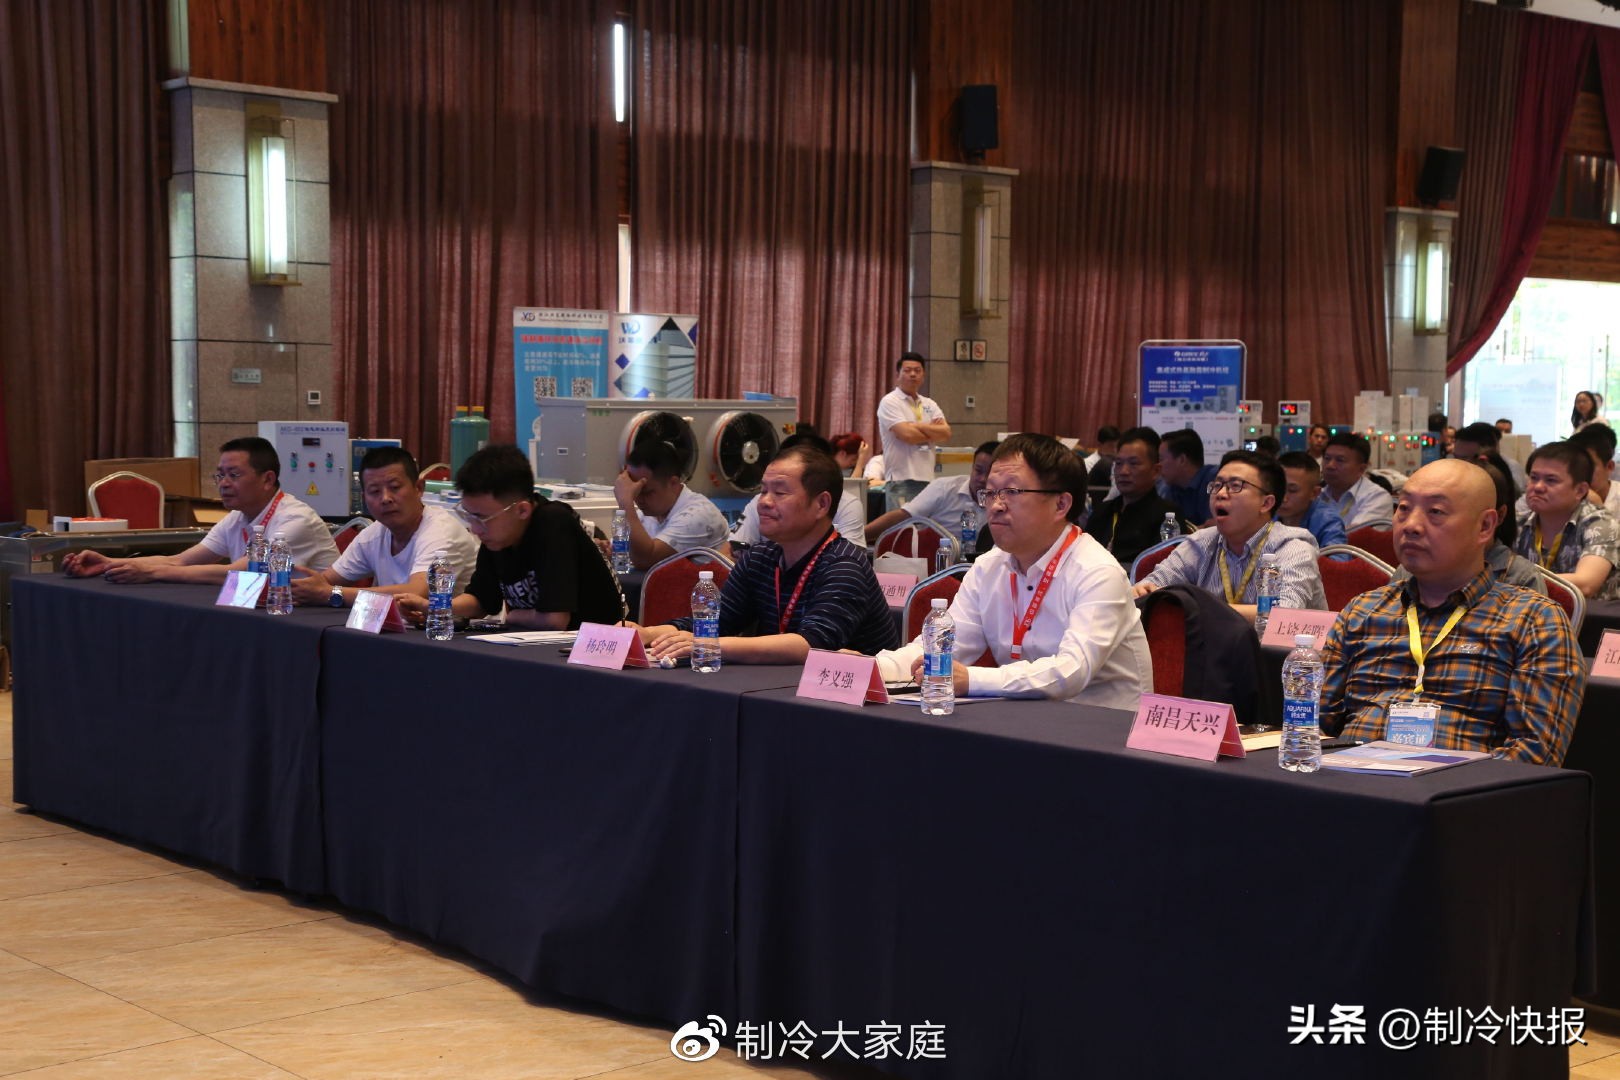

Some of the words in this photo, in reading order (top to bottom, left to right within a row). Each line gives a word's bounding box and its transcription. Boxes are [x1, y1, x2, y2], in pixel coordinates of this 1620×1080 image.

[1604, 648, 1620, 665] 江
[817, 667, 855, 689] 李义强
[1144, 704, 1221, 736] 南昌天兴
